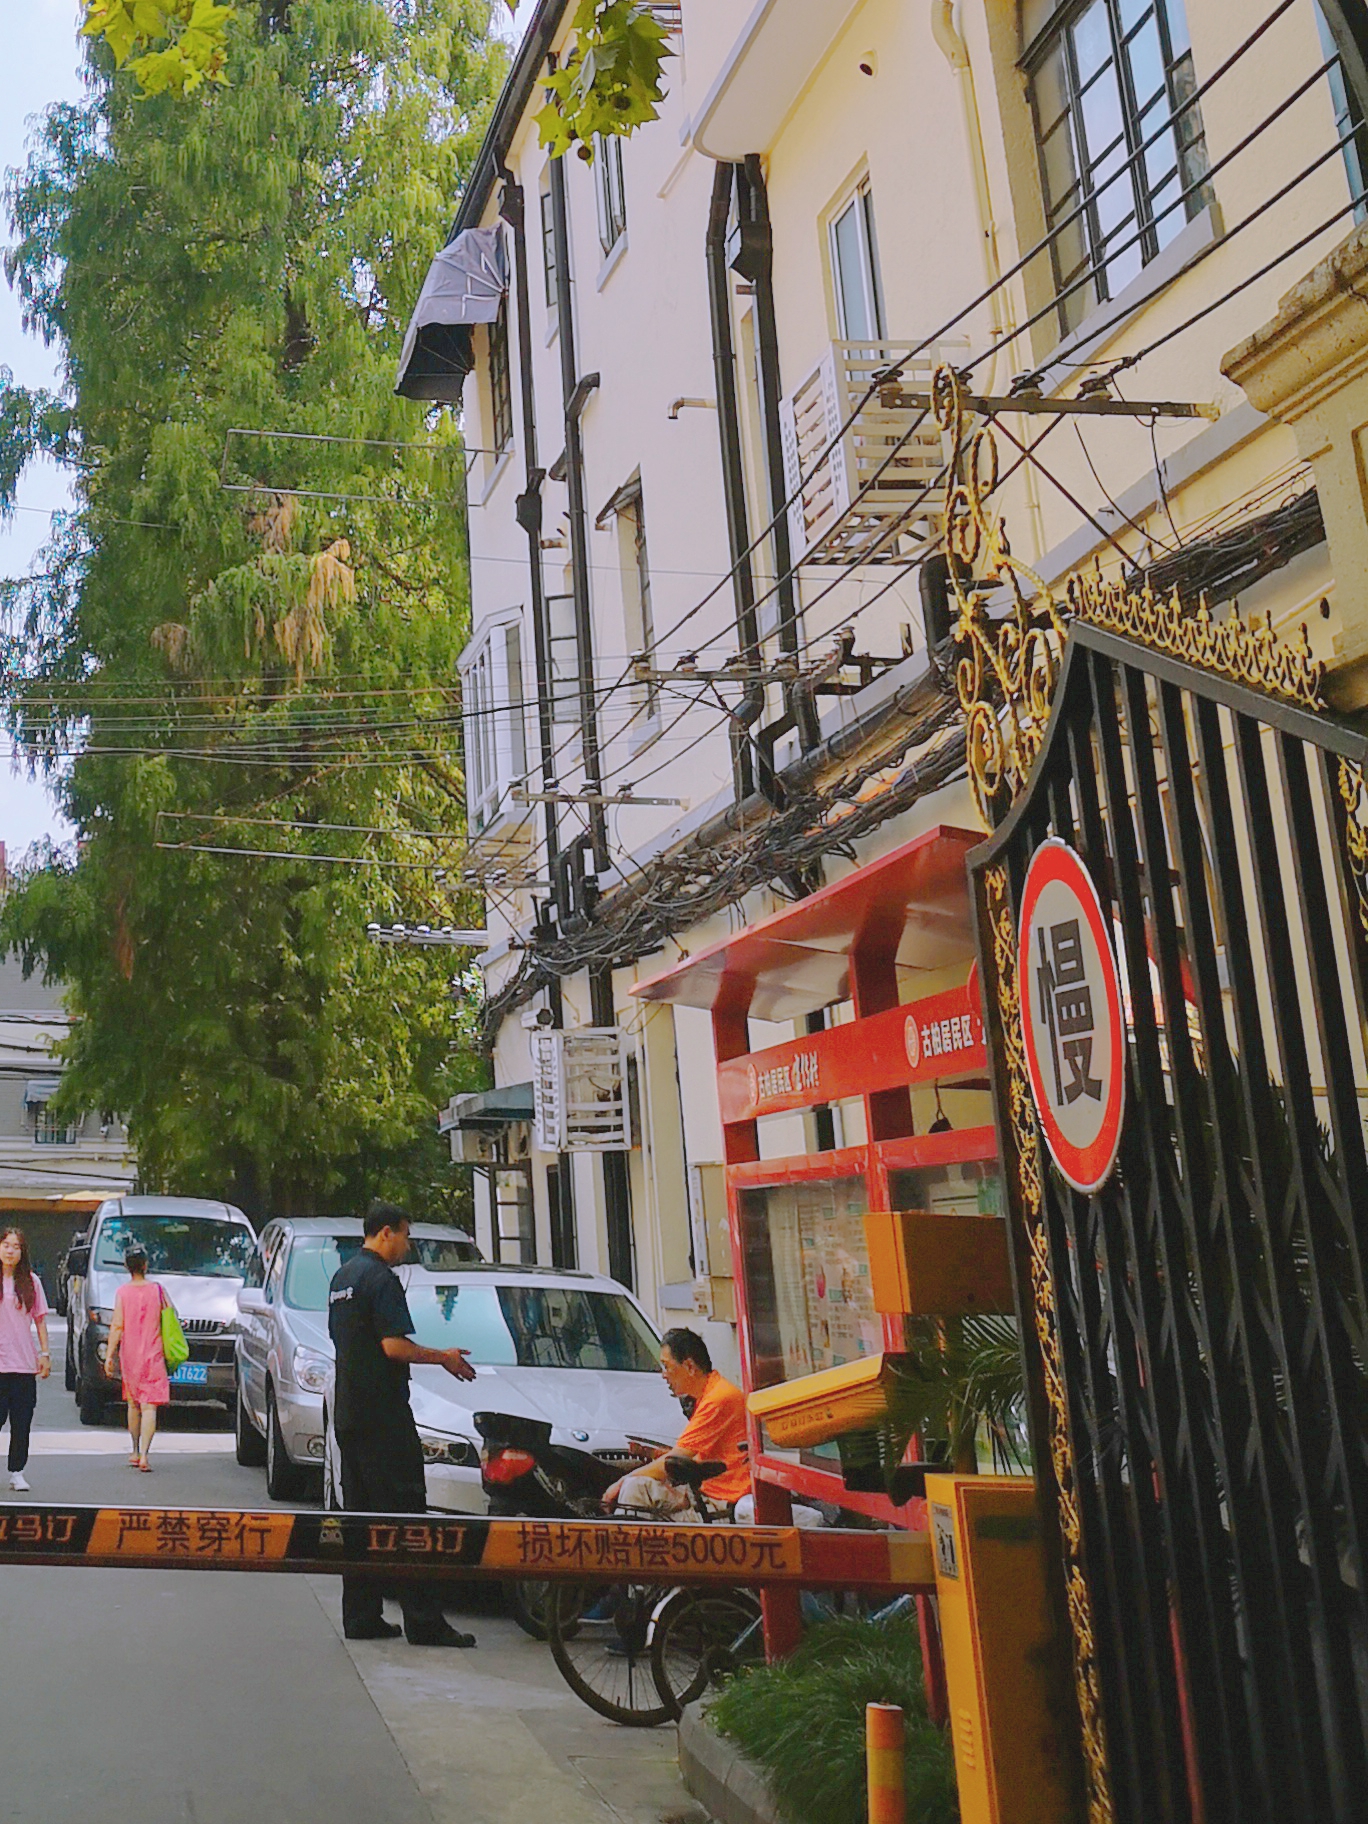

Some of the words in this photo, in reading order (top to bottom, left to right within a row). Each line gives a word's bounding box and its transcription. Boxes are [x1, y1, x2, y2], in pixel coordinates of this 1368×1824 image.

[921, 1014, 974, 1058] 古柏居民区
[1036, 918, 1103, 1107] 慢
[116, 1511, 272, 1556] 严禁穿行
[367, 1524, 467, 1553] 立马订
[517, 1521, 787, 1569] 损坏赔偿5000元
